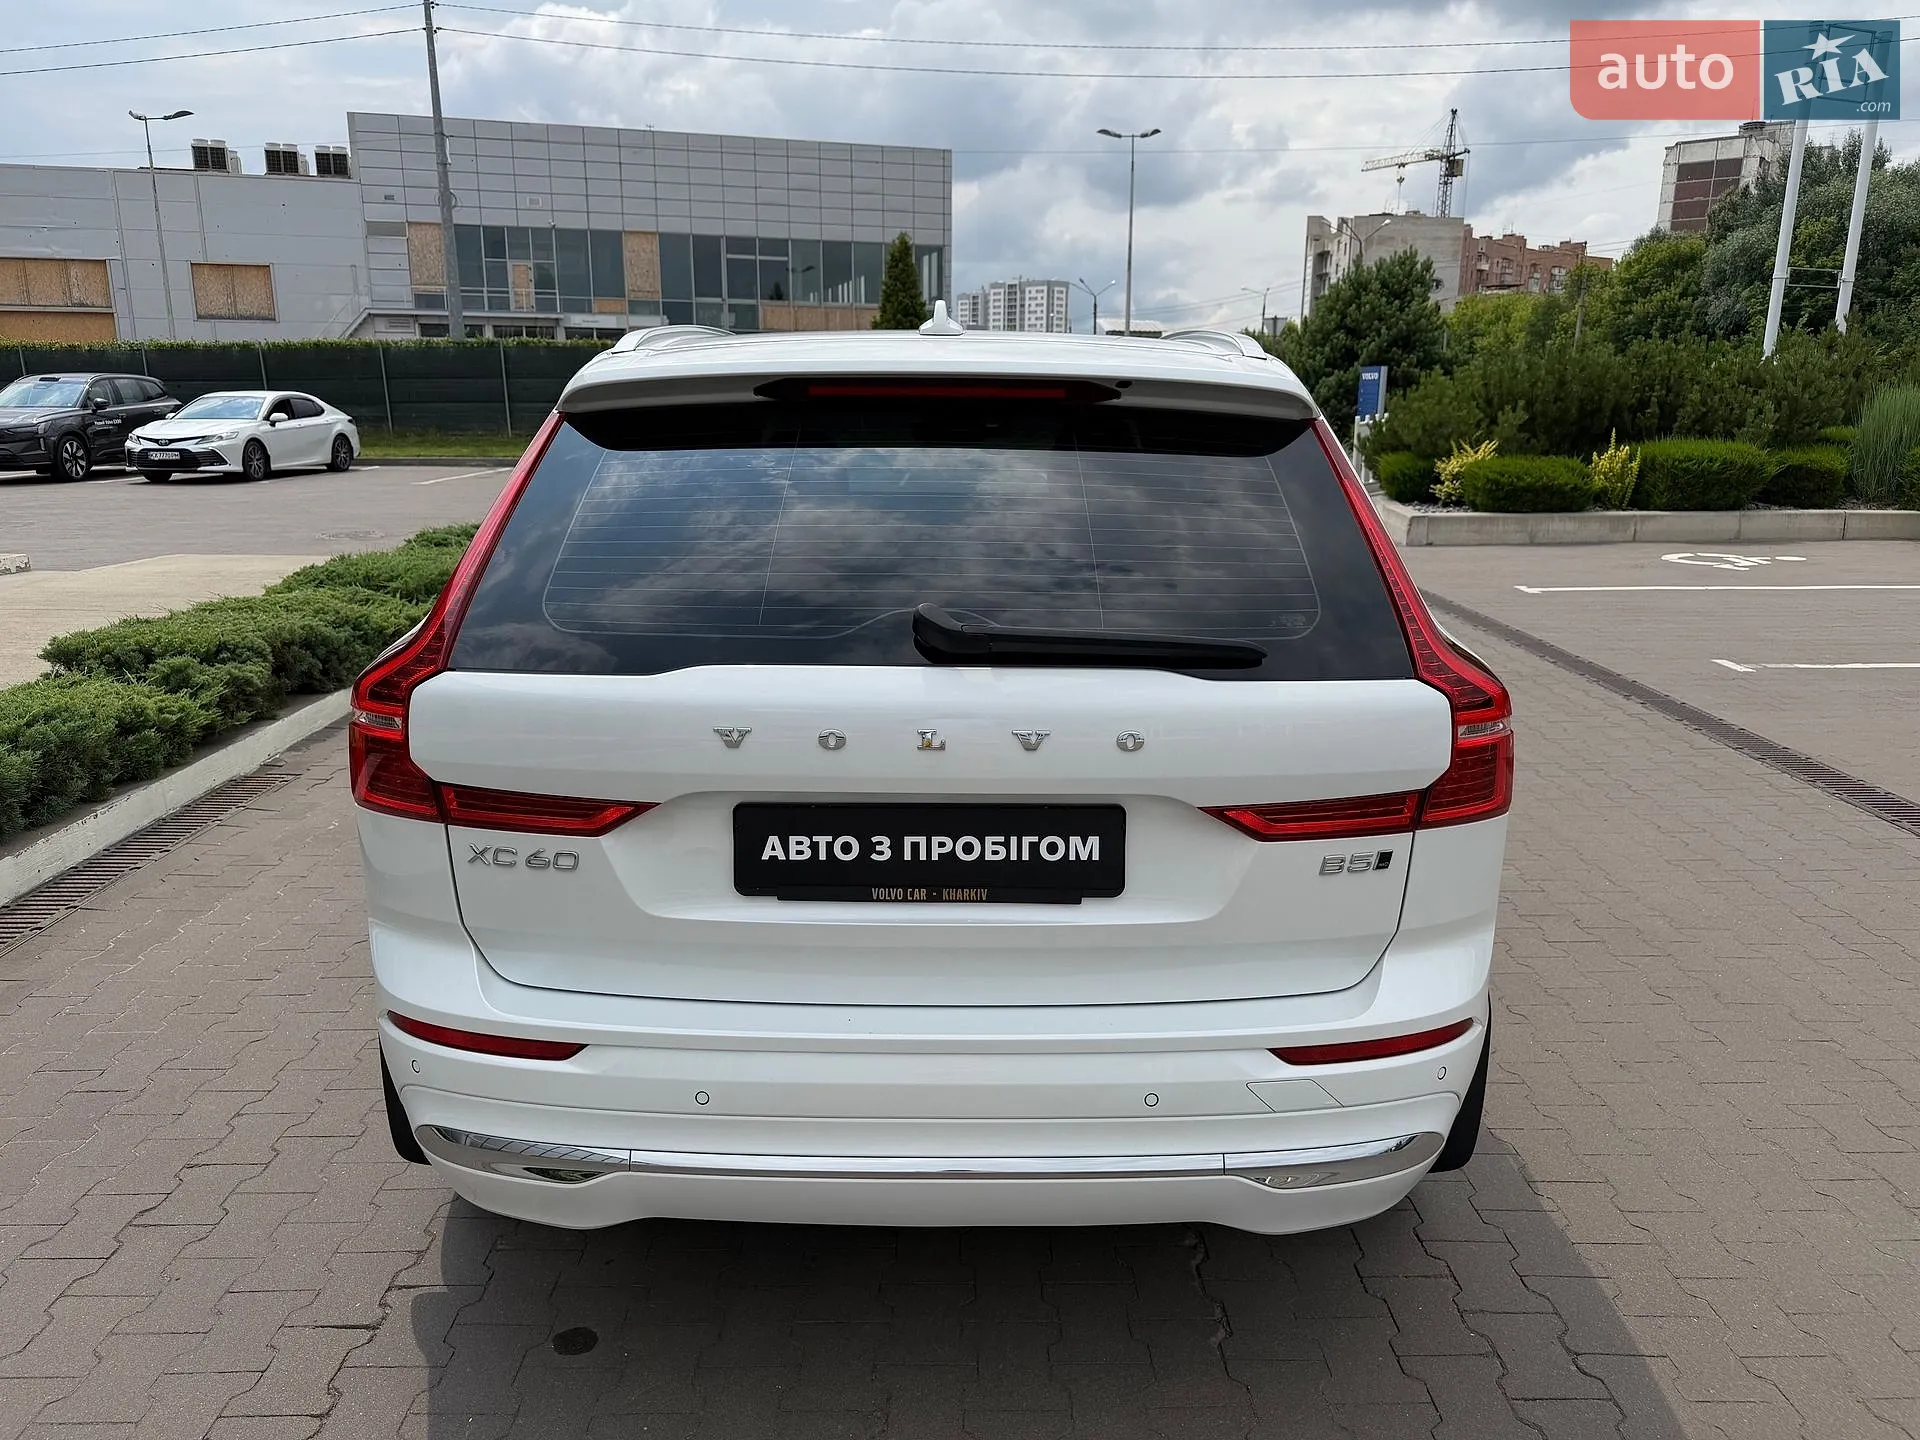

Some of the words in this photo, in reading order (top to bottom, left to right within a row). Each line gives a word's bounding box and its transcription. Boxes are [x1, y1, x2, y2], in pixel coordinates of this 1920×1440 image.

[713, 726, 1145, 753] VOLVO
[761, 835, 860, 861] АВТО
[904, 835, 1100, 862] ПРОБІГОМ
[871, 887, 903, 900] VOLVO
[907, 888, 927, 901] CAR
[942, 888, 988, 901] KHARKIV
